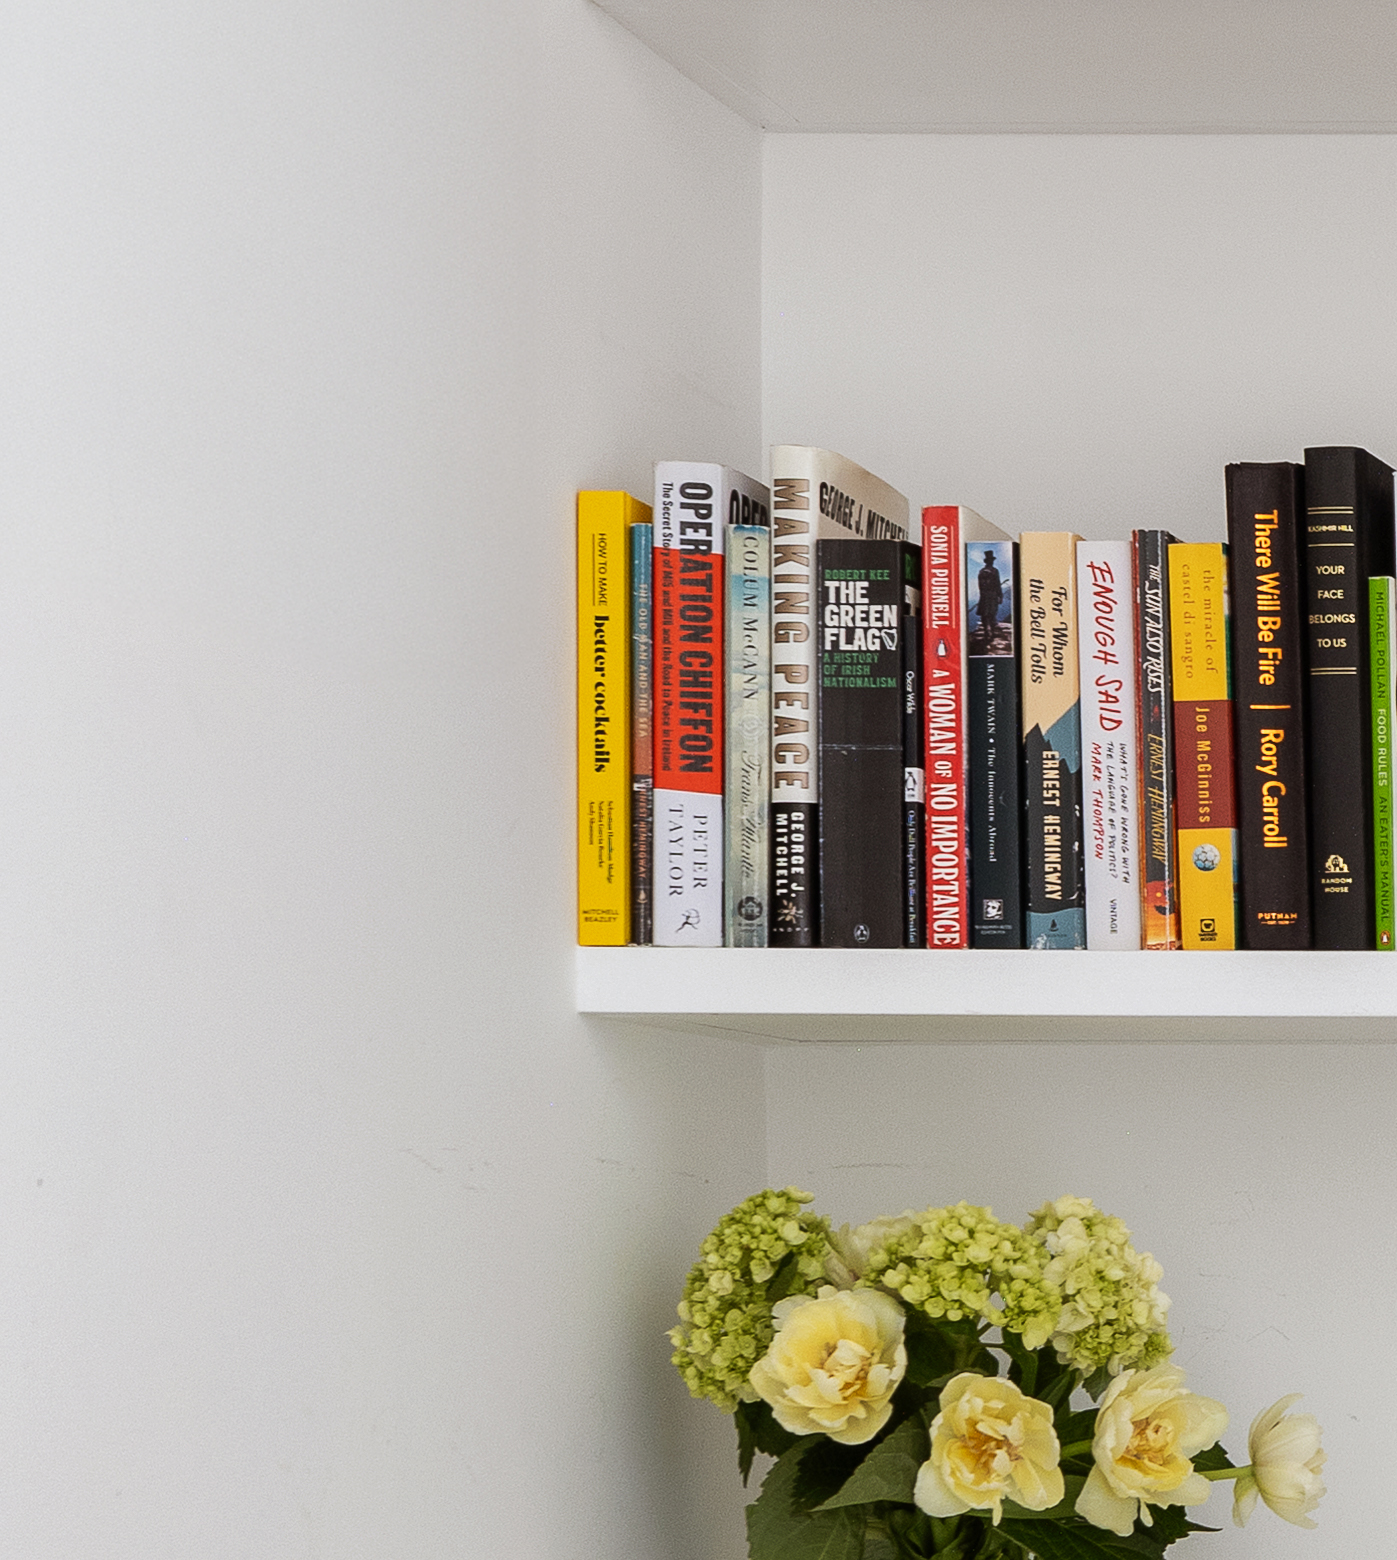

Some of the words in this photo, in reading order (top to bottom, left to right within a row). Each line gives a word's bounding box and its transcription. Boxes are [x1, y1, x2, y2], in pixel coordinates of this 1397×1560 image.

[678, 482, 713, 640] OPERATION
[774, 478, 809, 644] MAKING
[929, 526, 949, 565] SONIA
[1254, 510, 1277, 567] There
[824, 604, 897, 627] GREEN
[825, 581, 869, 603] THE
[931, 569, 950, 628] PURNELL
[1029, 579, 1045, 604] the
[1050, 587, 1068, 616] For
[1087, 561, 1120, 665] ENOUGH
[1256, 573, 1279, 610] Will
[593, 615, 610, 677] better
[824, 629, 881, 650] FLAG
[1030, 607, 1046, 639] Bell
[1258, 617, 1280, 642] Be
[1030, 643, 1047, 684] Tolls
[1052, 623, 1068, 678] Whom
[1259, 648, 1280, 685] Fire
[593, 681, 610, 772] cocktails
[680, 650, 713, 773] CHIFFON
[775, 665, 809, 788] PEACE
[1098, 674, 1124, 731] SAID
[1257, 729, 1284, 774] Rory
[1262, 780, 1286, 847] Carroll
